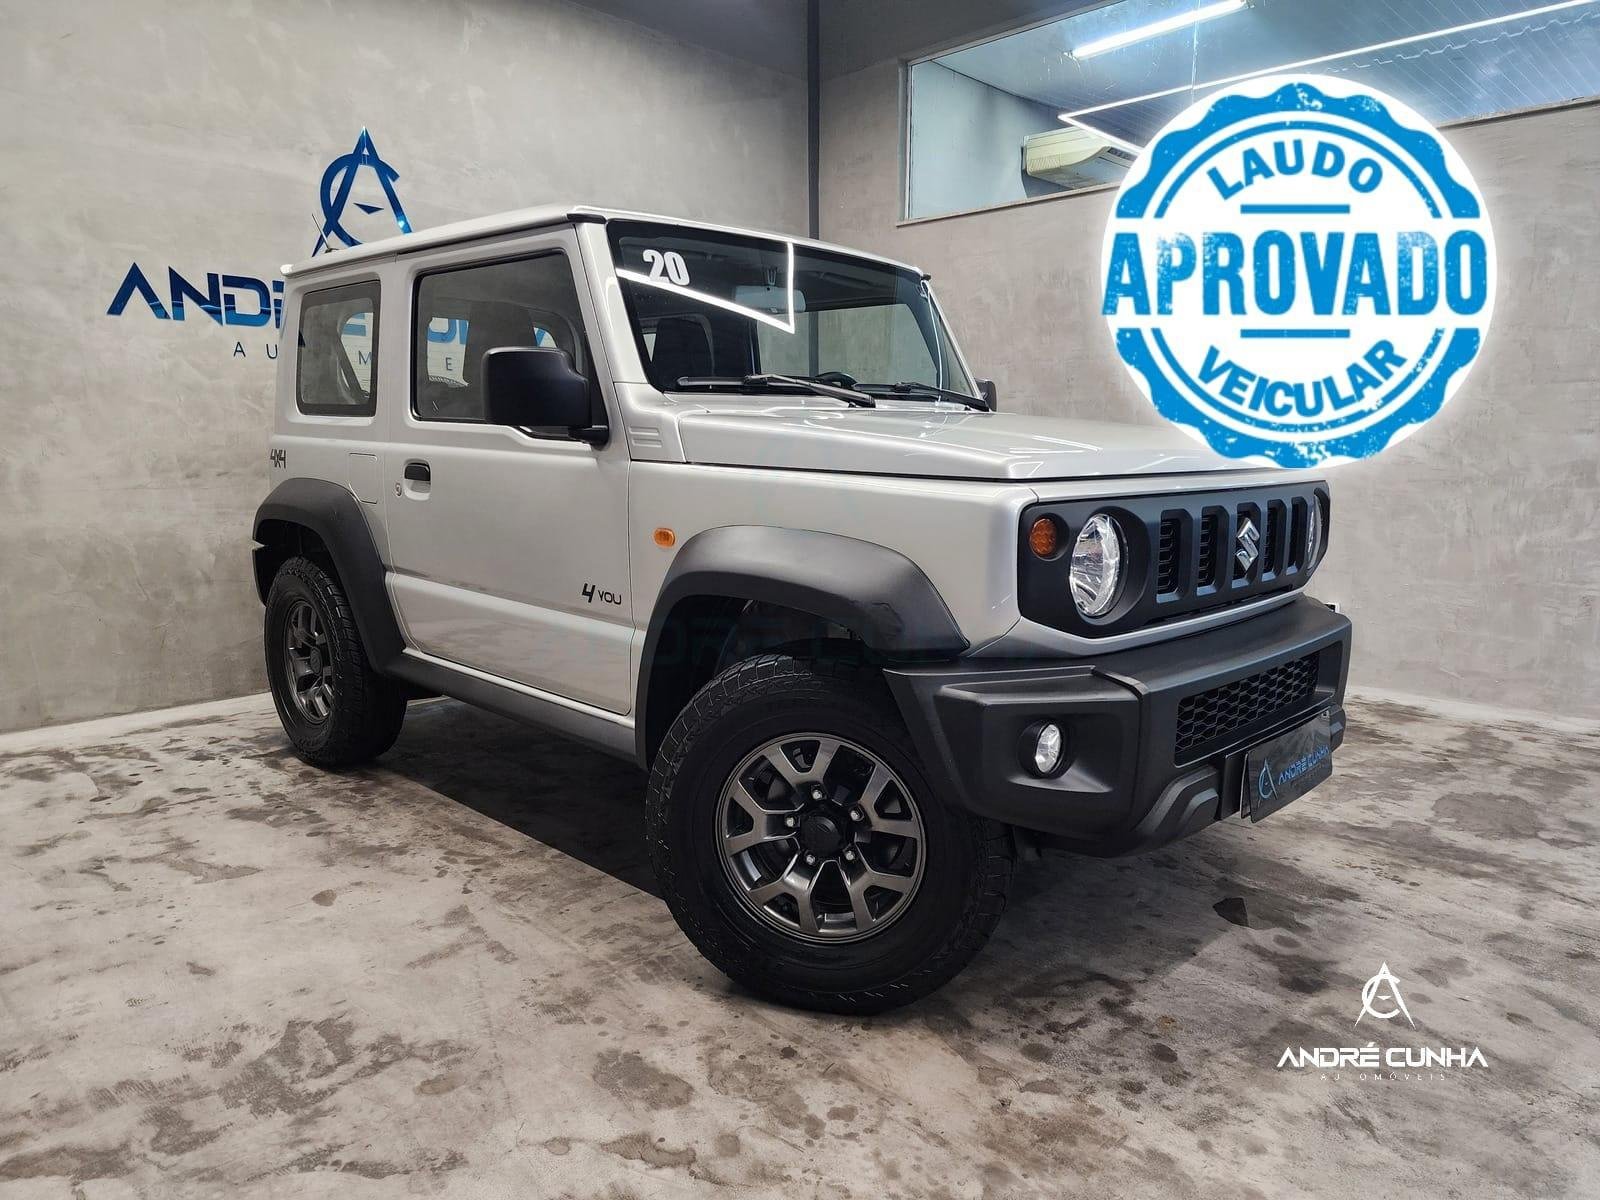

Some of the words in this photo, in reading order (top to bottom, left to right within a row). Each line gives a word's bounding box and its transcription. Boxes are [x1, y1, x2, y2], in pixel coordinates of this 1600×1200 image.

[643, 249, 691, 286] 20
[581, 582, 596, 603] 4
[597, 589, 622, 605] YOU
